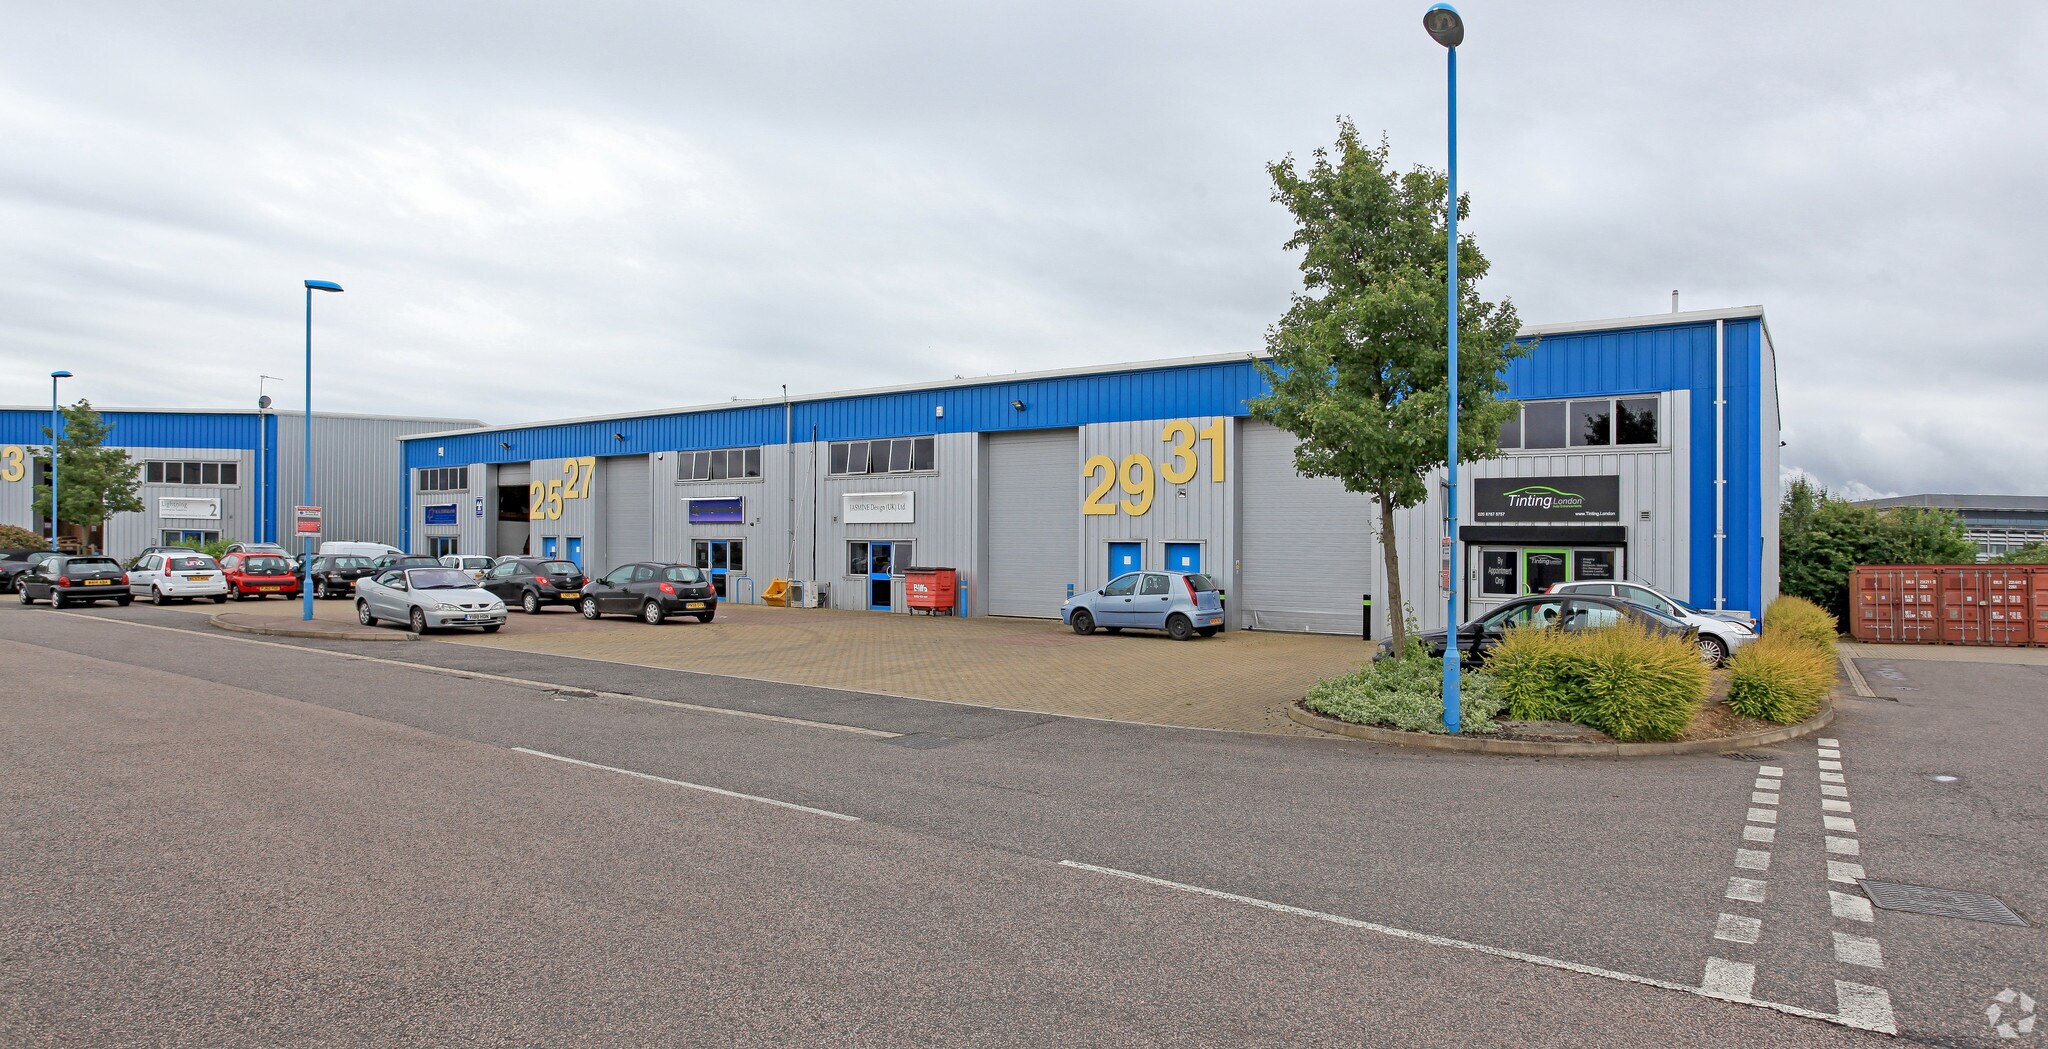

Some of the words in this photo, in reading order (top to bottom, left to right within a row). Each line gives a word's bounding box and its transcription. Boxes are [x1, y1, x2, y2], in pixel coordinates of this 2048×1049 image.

[1161, 417, 1225, 485] 31
[563, 456, 596, 499] 27
[1083, 453, 1155, 516] 29
[530, 480, 563, 520] 25
[209, 503, 218, 517] 2
[849, 503, 870, 512] JASMINE
[870, 503, 886, 513] Design
[886, 503, 897, 512] (UK)
[897, 503, 906, 511] Ltd
[1497, 556, 1504, 566] By
[1487, 566, 1513, 576] Appointment
[1494, 576, 1505, 587] Only
